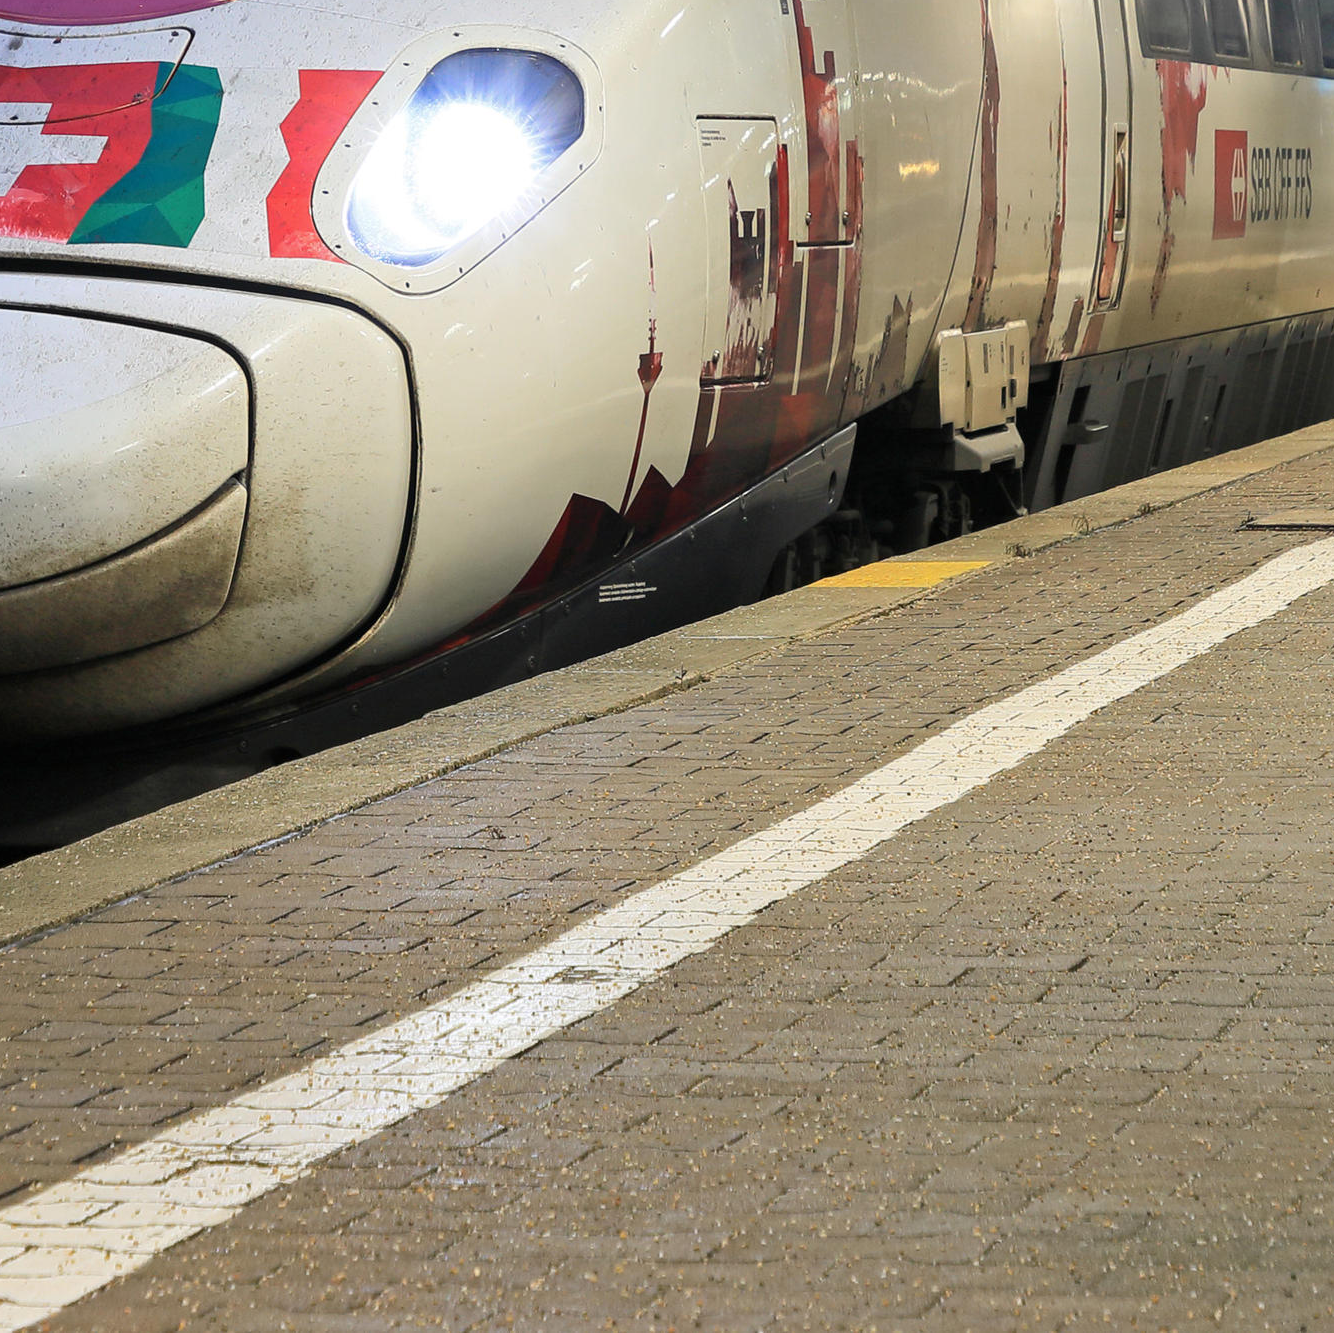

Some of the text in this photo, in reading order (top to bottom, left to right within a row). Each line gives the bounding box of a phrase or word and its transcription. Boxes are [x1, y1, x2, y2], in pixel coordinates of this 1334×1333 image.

[1250, 147, 1313, 223] SBB CFF FFS
